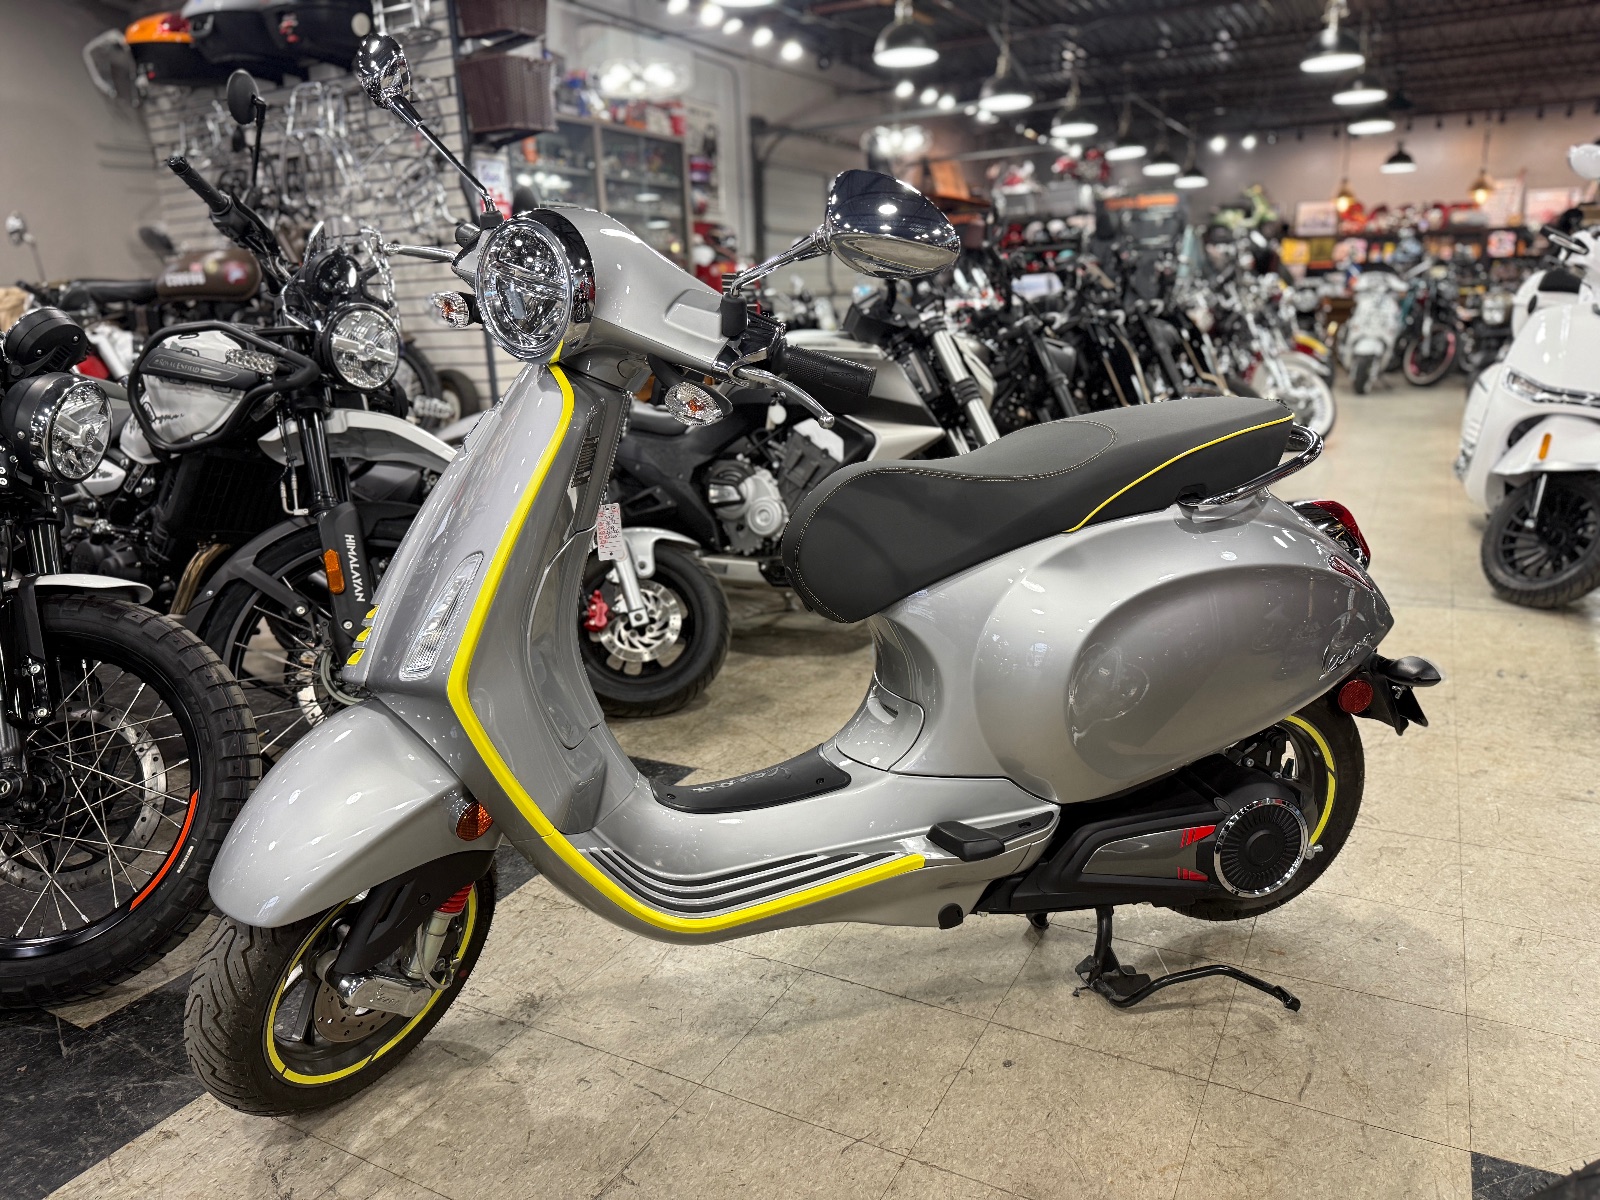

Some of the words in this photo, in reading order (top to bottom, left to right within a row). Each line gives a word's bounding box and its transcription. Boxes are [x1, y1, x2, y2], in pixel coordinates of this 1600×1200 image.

[158, 357, 176, 368] ROYAL
[176, 361, 200, 373] ENFIELD
[344, 533, 366, 602] HIMALAYAN
